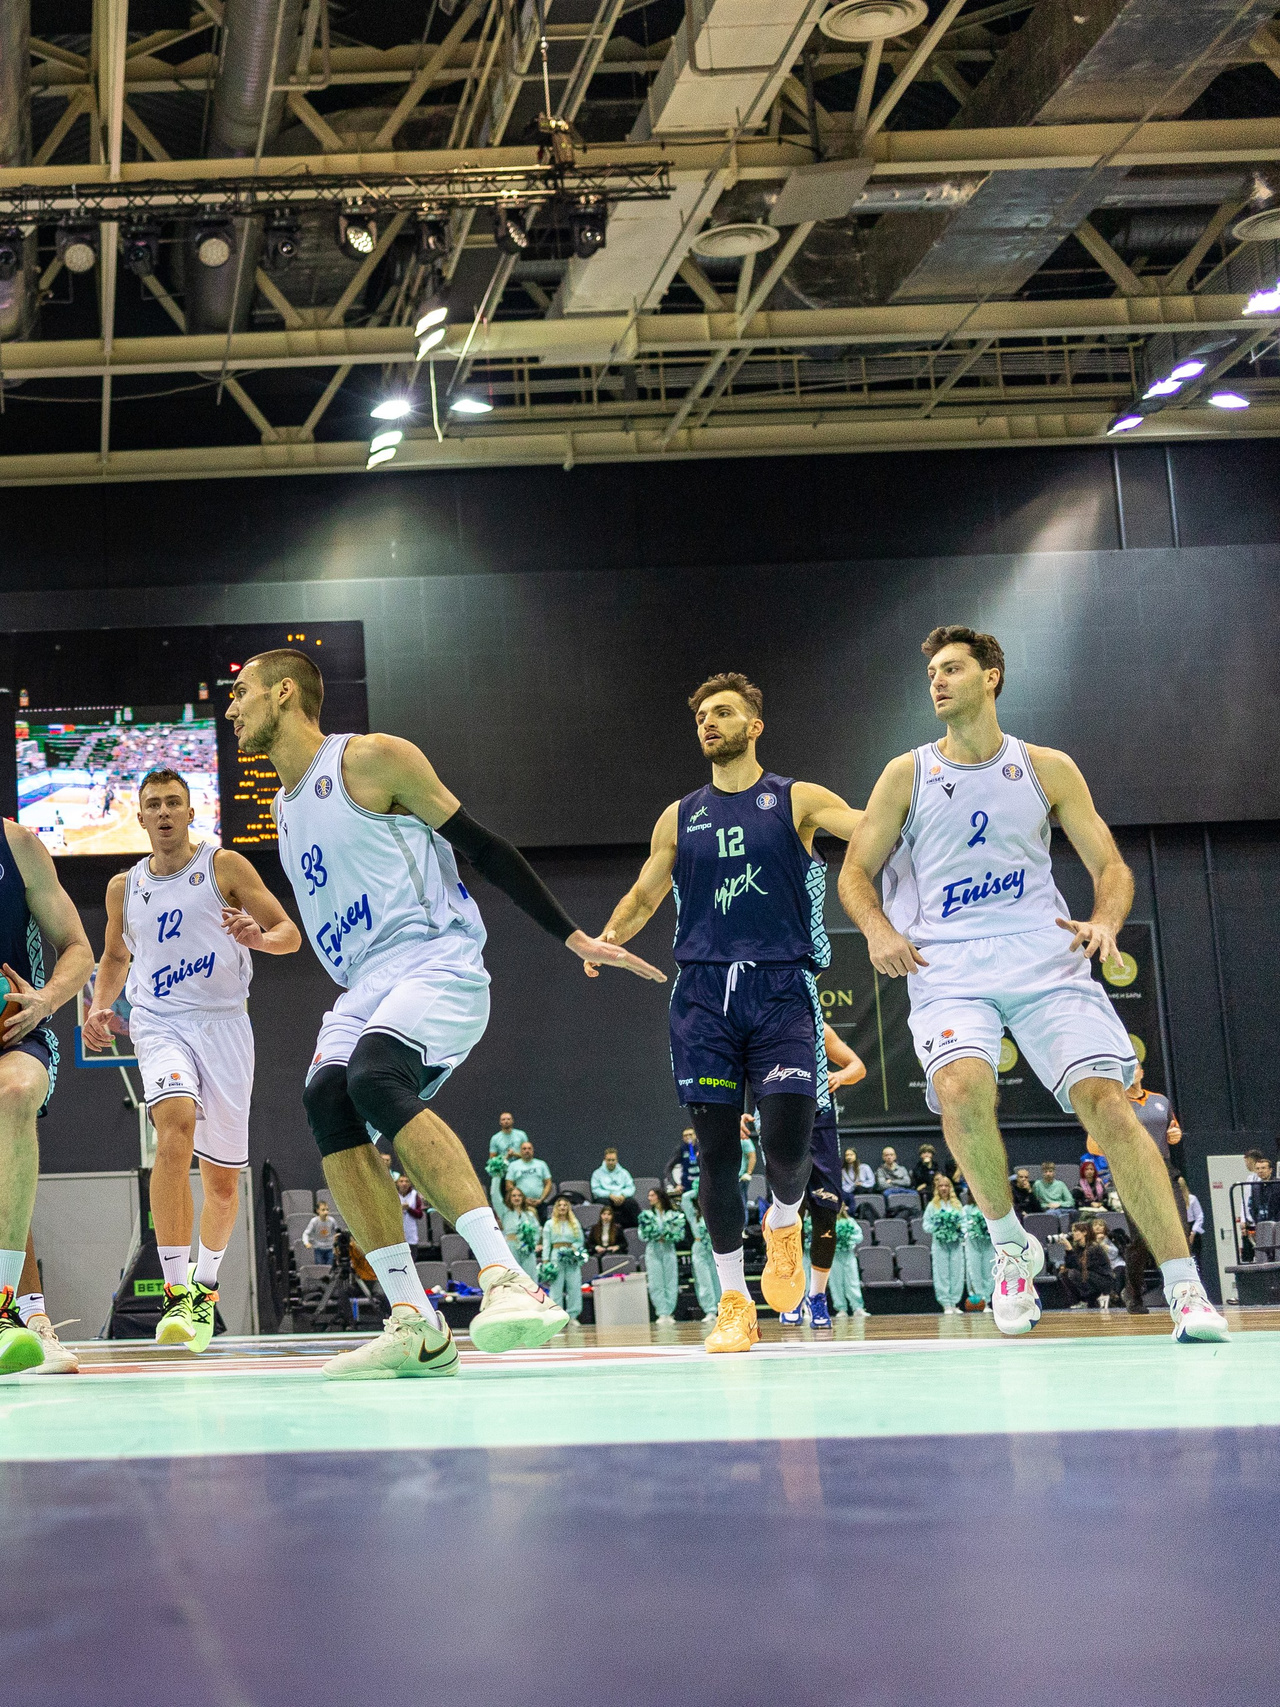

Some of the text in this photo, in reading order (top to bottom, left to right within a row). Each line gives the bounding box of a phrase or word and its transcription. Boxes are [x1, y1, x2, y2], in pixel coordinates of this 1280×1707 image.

[687, 822, 712, 833] Kempa
[715, 826, 746, 858] 12
[967, 810, 989, 849] 2
[301, 844, 328, 896] 33
[941, 868, 1026, 919] Enisey
[157, 908, 183, 943] 12
[151, 951, 216, 998] Enisey
